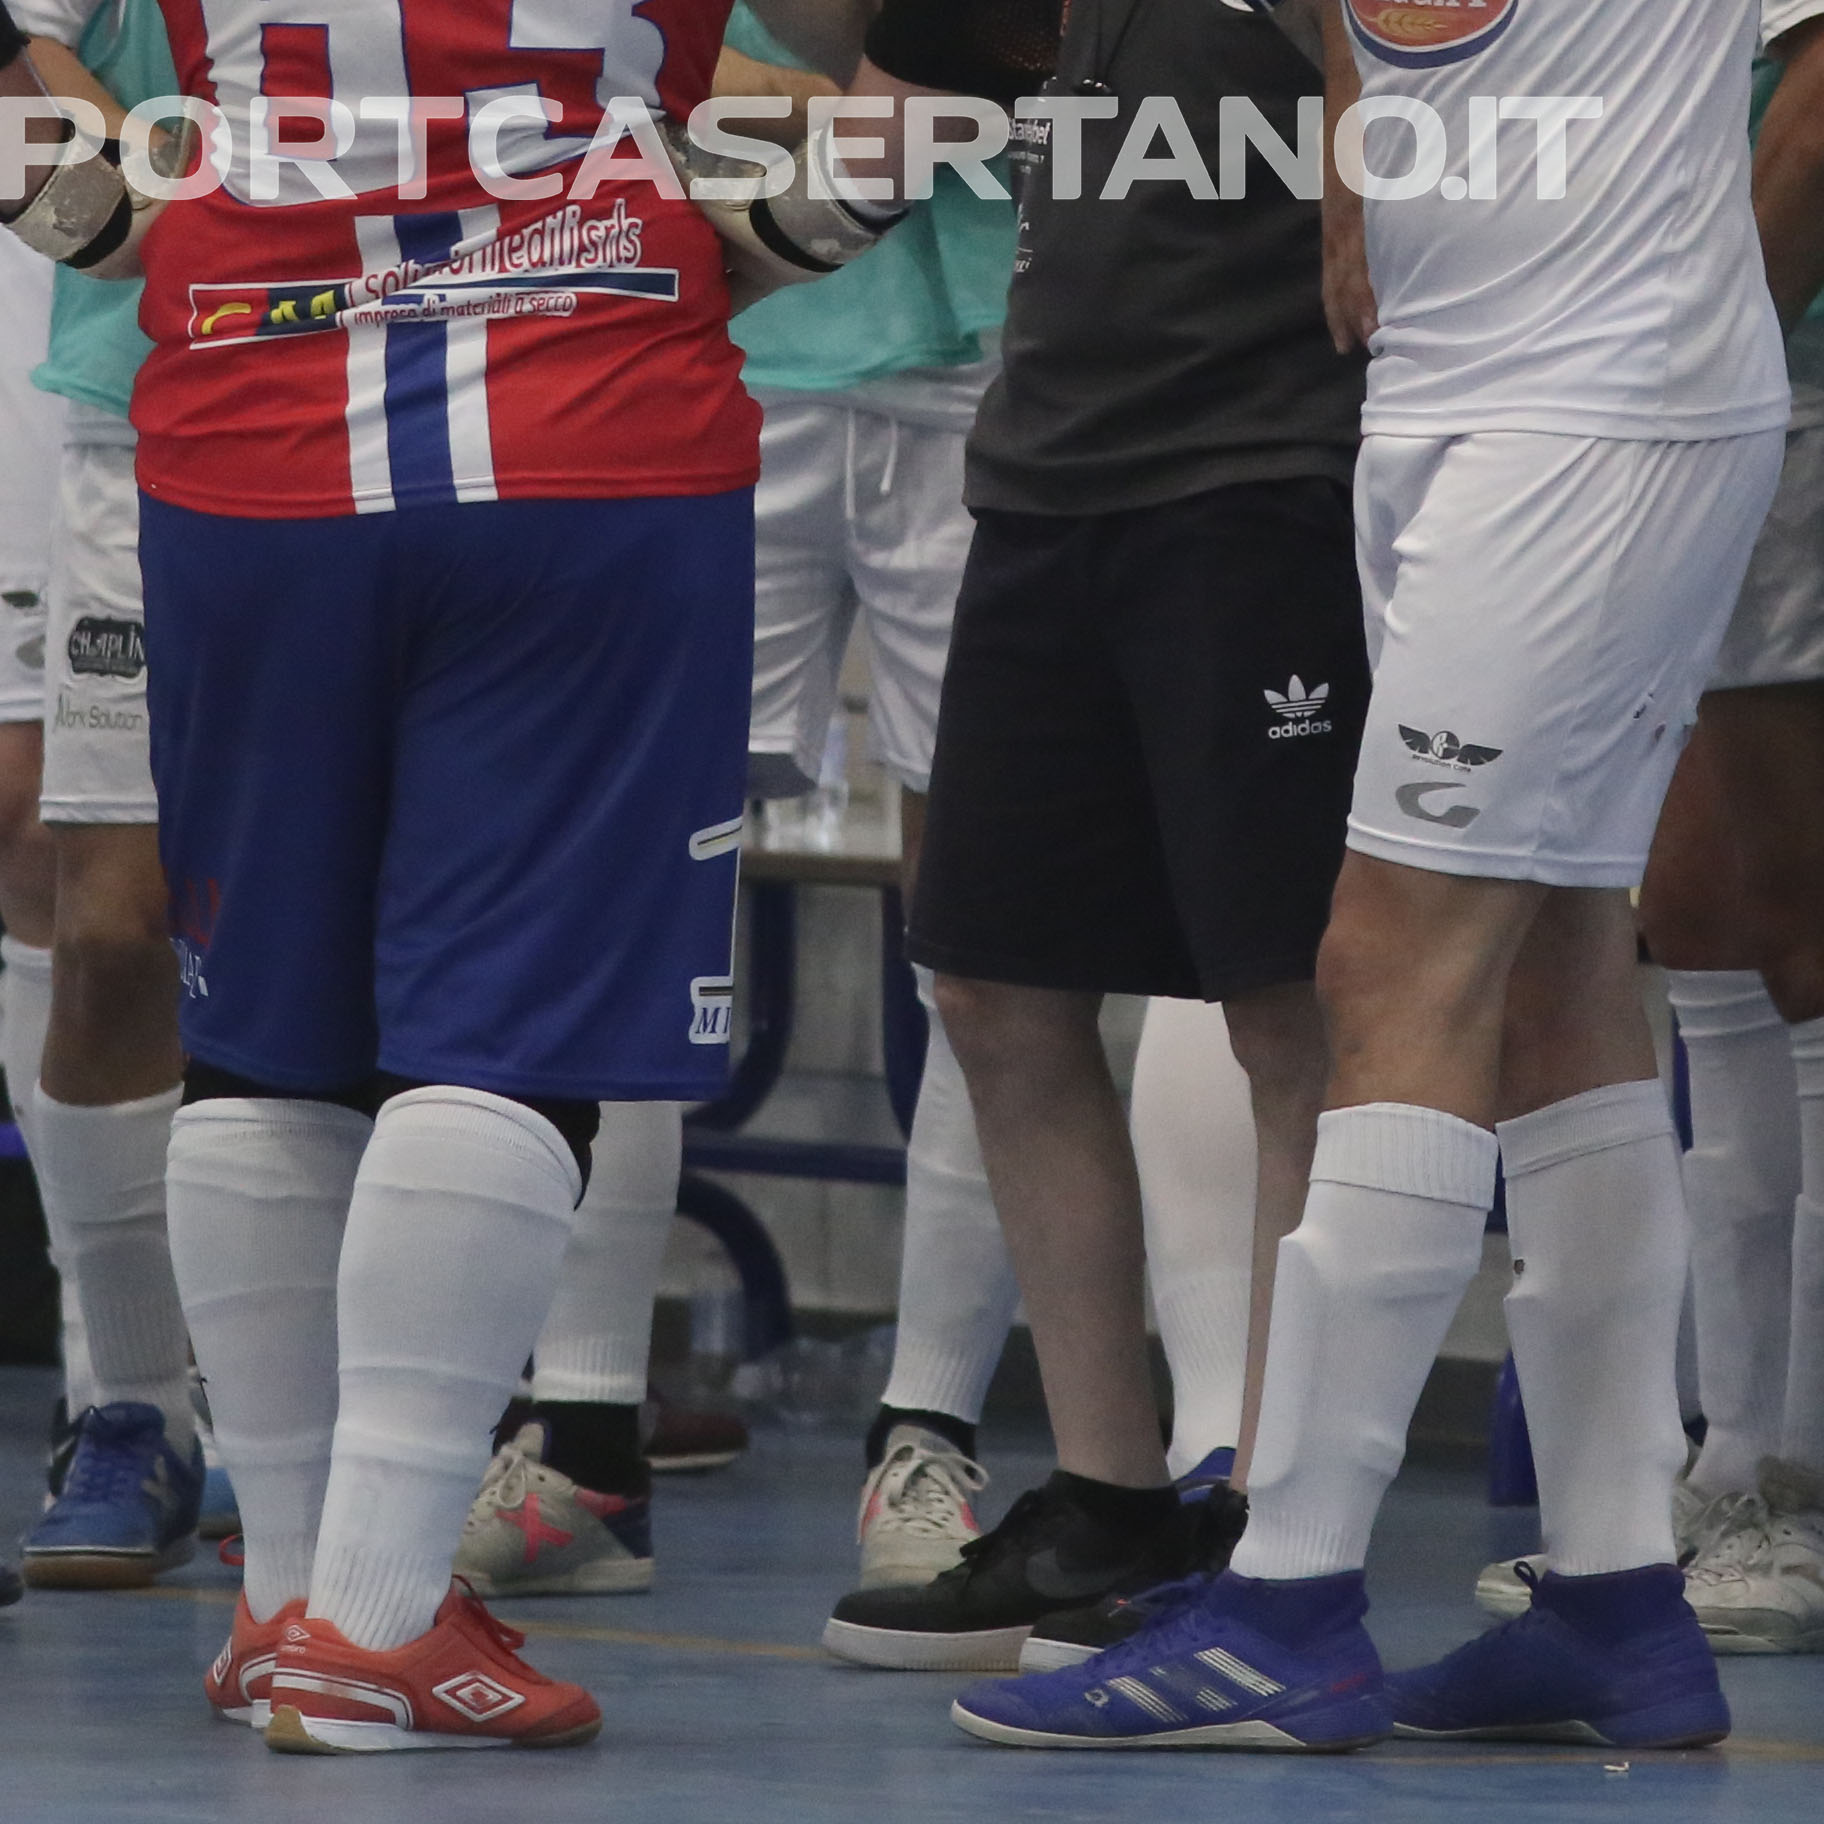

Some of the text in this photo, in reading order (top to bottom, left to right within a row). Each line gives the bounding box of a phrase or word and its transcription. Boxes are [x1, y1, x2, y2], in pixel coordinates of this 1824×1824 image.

[422, 297, 437, 317] di
[528, 293, 574, 313] secco
[1268, 719, 1333, 740] adidas
